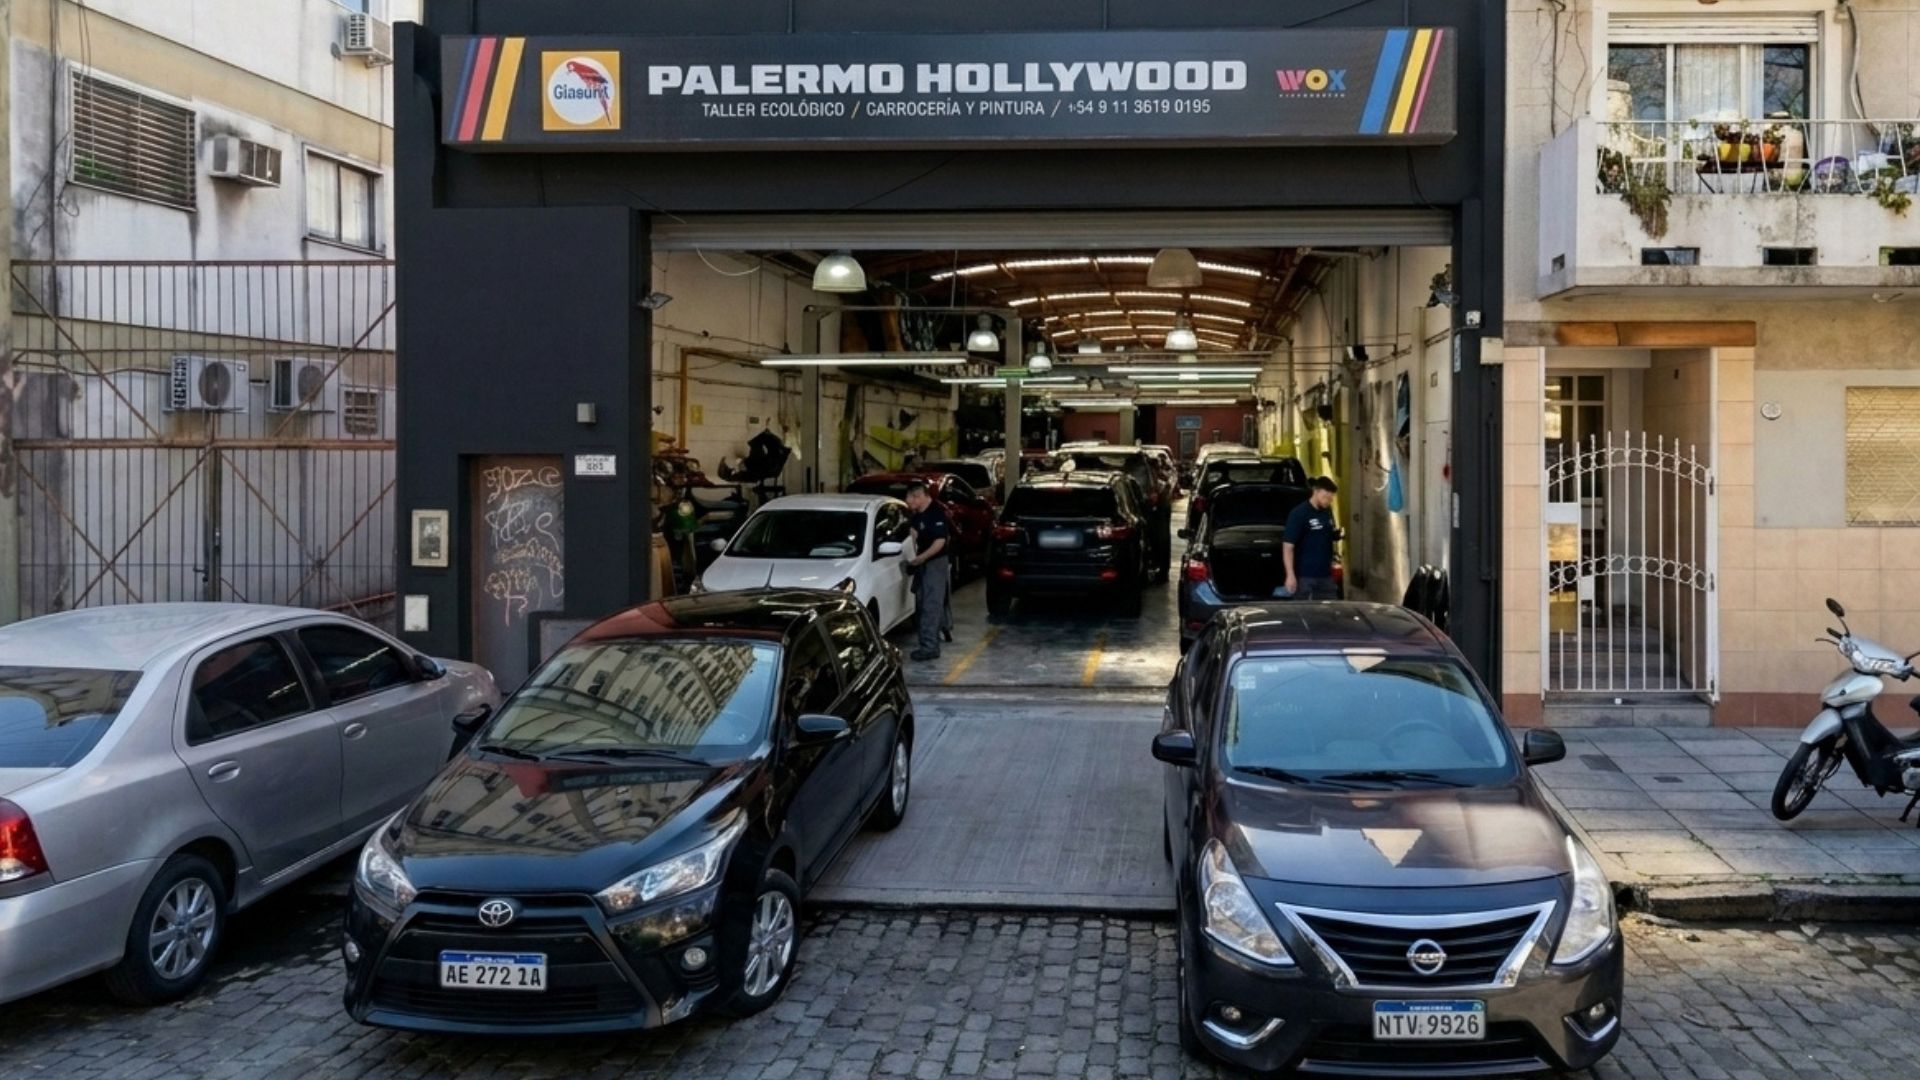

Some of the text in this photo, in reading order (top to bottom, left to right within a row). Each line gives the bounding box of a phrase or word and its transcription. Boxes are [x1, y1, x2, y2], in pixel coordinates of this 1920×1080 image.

[648, 60, 1247, 96] PALERMO HOLLYWOOD
[1275, 68, 1347, 91] WOX
[702, 102, 756, 118] TALLER
[866, 97, 962, 117] CARROCERÍA
[965, 100, 976, 116] Y
[979, 99, 1045, 116] PINTURA
[1098, 98, 1108, 114] 9
[1112, 99, 1128, 114] 11
[1134, 98, 1170, 114] 3619
[1174, 98, 1211, 114] 0195
[446, 964, 541, 987] AE 272 1A
[1378, 1014, 1418, 1036] NTV
